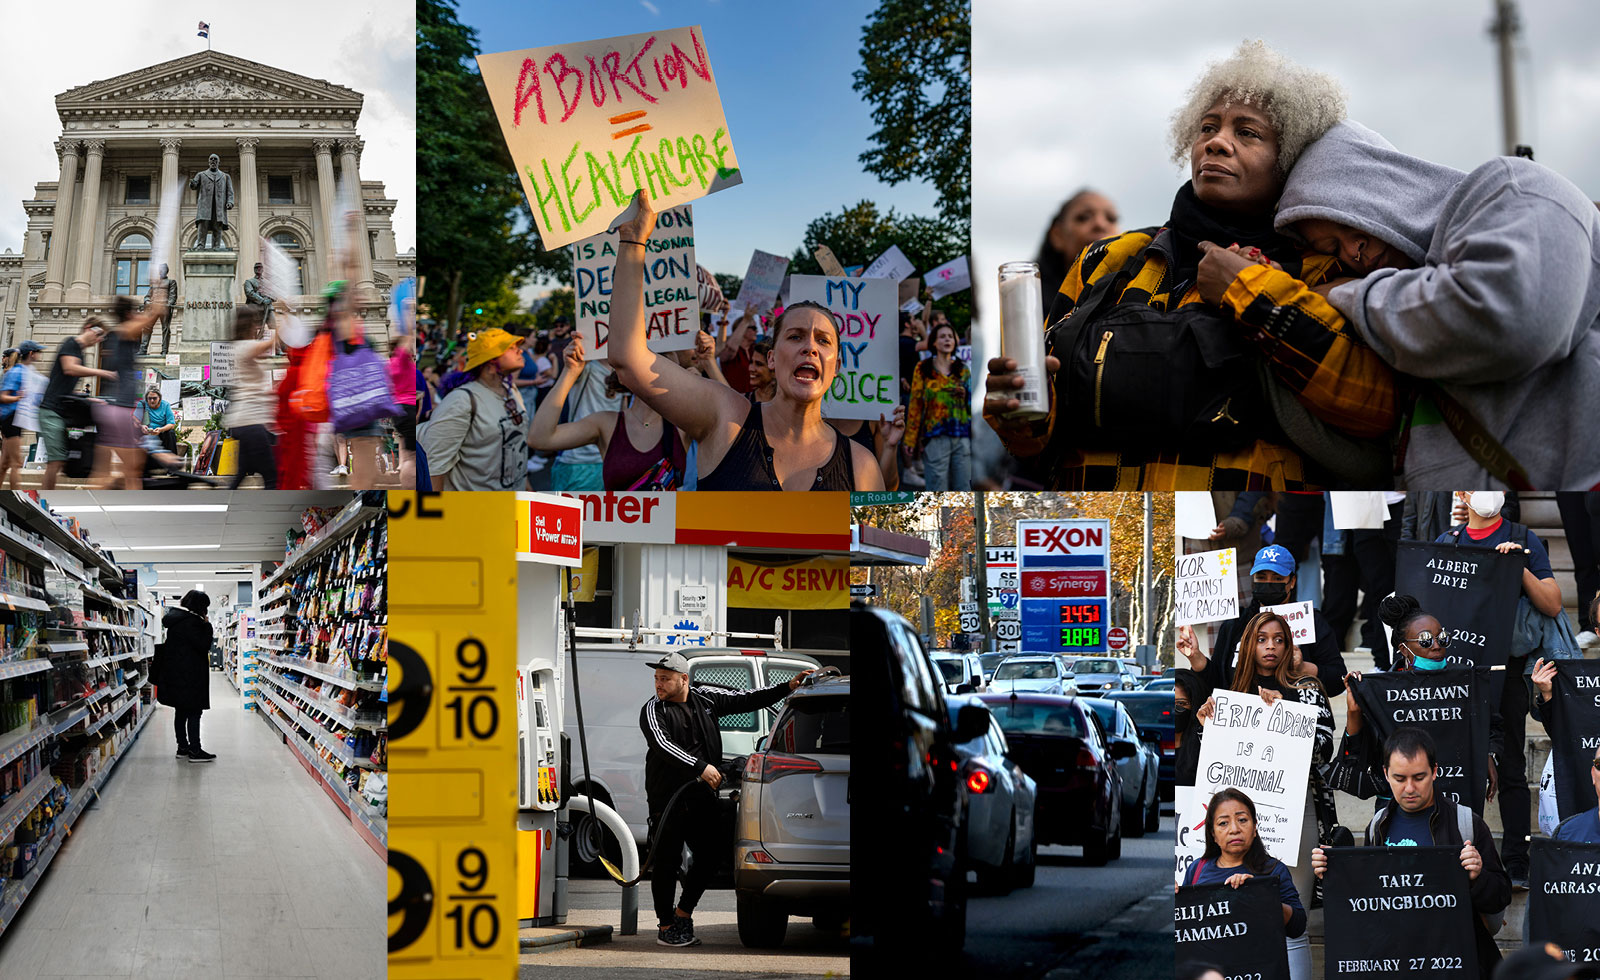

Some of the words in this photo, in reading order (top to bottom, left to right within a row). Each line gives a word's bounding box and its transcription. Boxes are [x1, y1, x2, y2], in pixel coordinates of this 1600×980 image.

[513, 26, 711, 127] ABORTION
[524, 127, 740, 233] HEALTHCARE
[577, 243, 596, 261] IS
[601, 241, 617, 257] A
[645, 236, 694, 253] RSONAL
[576, 253, 690, 299] DEION
[580, 300, 610, 318] NO
[645, 287, 696, 308] LEGAL
[826, 280, 866, 310] MY
[187, 301, 232, 310] MORTON
[595, 307, 689, 349] DATE
[832, 310, 882, 340] ODY
[824, 371, 893, 403] OICE
[868, 492, 893, 502] Road
[535, 527, 560, 543] V-Power
[1024, 526, 1102, 554] EXXON
[986, 551, 1017, 562] U-H
[1261, 548, 1280, 562] NY
[1426, 558, 1479, 575] ALBERT
[726, 567, 773, 592] A/C
[1049, 578, 1098, 592] Synergy
[1432, 573, 1468, 590] DRYE
[1182, 578, 1224, 600] AGAINST
[961, 603, 976, 611] WEST
[1001, 593, 1017, 605] 97
[1195, 597, 1236, 620] RACISM
[962, 617, 978, 629] 50
[998, 624, 1019, 636] 301
[1452, 629, 1486, 647] 2022
[1386, 685, 1470, 702] DASHAWN
[1213, 696, 1263, 728] ERIC
[1267, 702, 1315, 738] ADAMS
[1393, 707, 1463, 722] CARTER
[1237, 742, 1254, 756] IS
[1261, 745, 1274, 762] A
[1207, 762, 1285, 794] CRIMINAL
[1436, 766, 1464, 777] 022
[1379, 873, 1425, 888] TARZ
[1348, 894, 1457, 912] YOUNGBLOOD
[1338, 959, 1401, 973] FEBRUARY
[1409, 957, 1426, 970] 27
[1430, 957, 1463, 970] 2022
